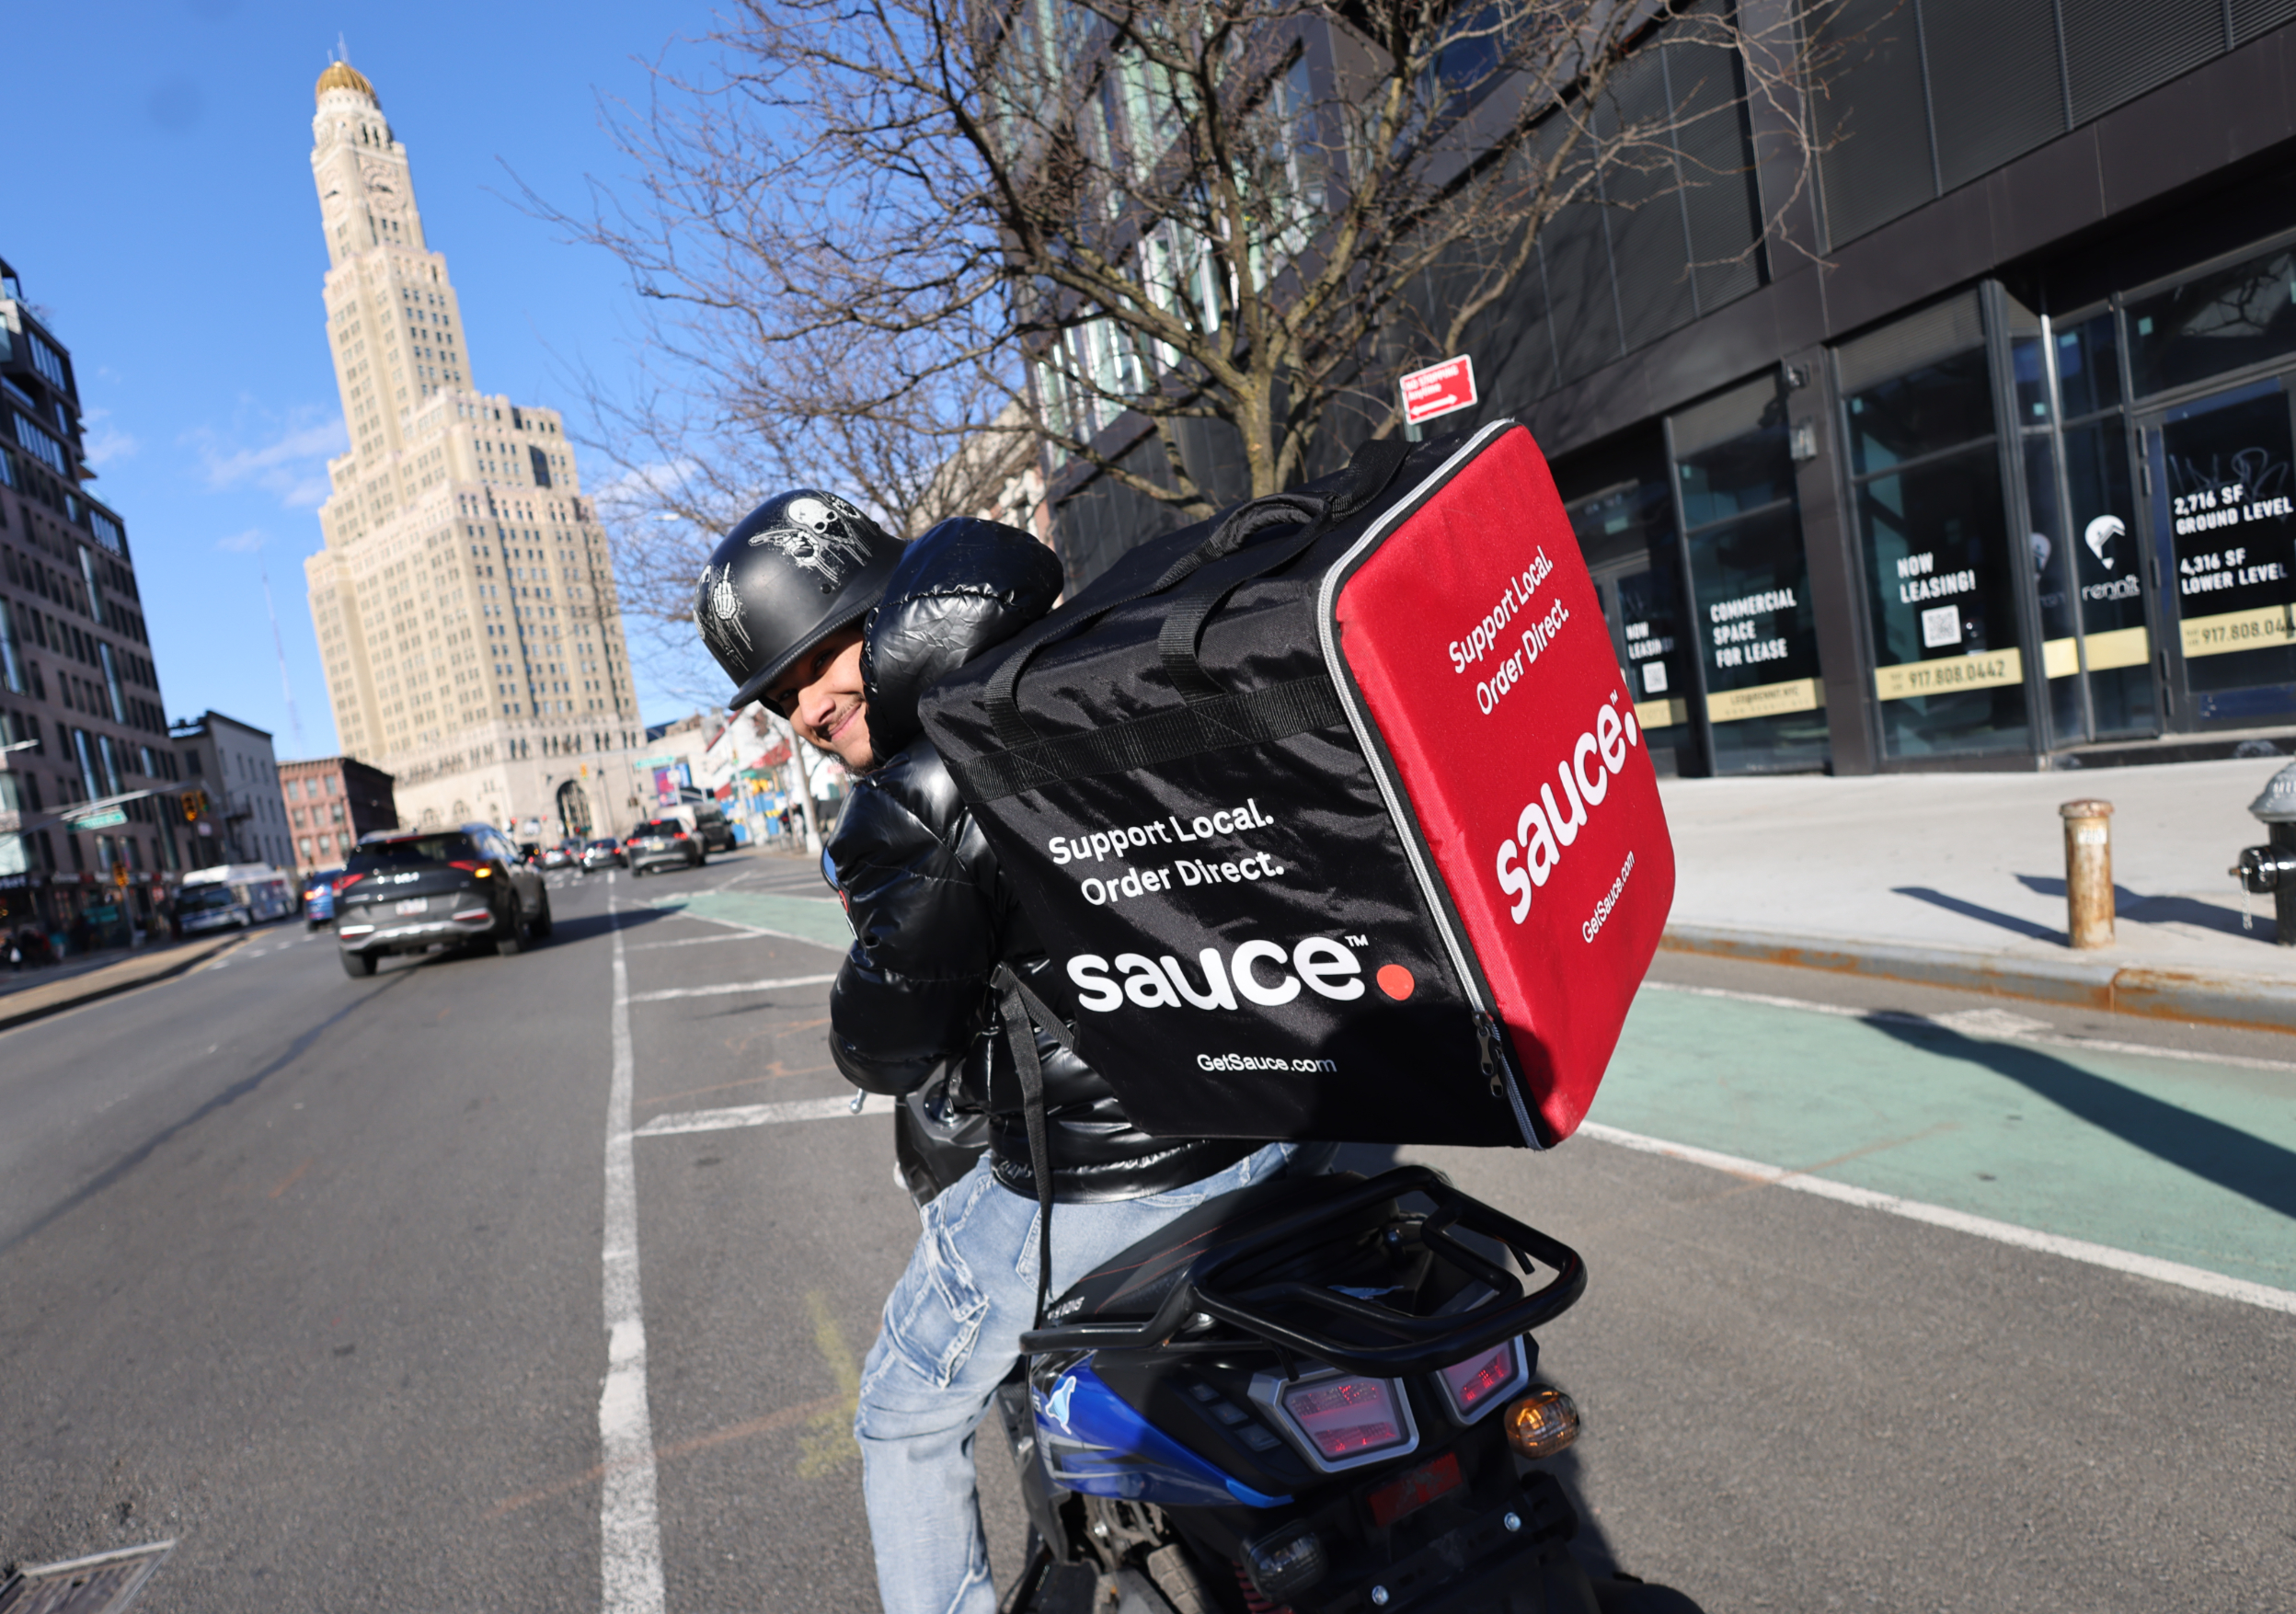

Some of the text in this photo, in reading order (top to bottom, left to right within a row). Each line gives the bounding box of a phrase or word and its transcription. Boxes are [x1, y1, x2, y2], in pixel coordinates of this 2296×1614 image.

[2175, 484, 2244, 516] 2,716 SF
[2175, 496, 2294, 535] GROUND LEVEL
[1897, 551, 1934, 578] NOW
[2180, 547, 2246, 577] 4,316 SF
[2181, 562, 2289, 595] LOWER LEVEL
[1900, 568, 1977, 603] LEASING!
[1448, 544, 1554, 674] Support Local.
[1709, 587, 1797, 623] COMMERCIAL
[1625, 621, 1649, 641] NOW
[1712, 620, 1757, 646] SPACE
[1476, 598, 1570, 715] Order Direct.
[1716, 637, 1789, 669] FOR LEASE
[1909, 658, 2007, 689] 917.808.0442
[1049, 798, 1275, 865] Support Local.
[1081, 851, 1285, 906] Order Direct.
[1582, 850, 1636, 944] GetSauce.com
[1197, 1053, 1337, 1073] GetSauce.com
